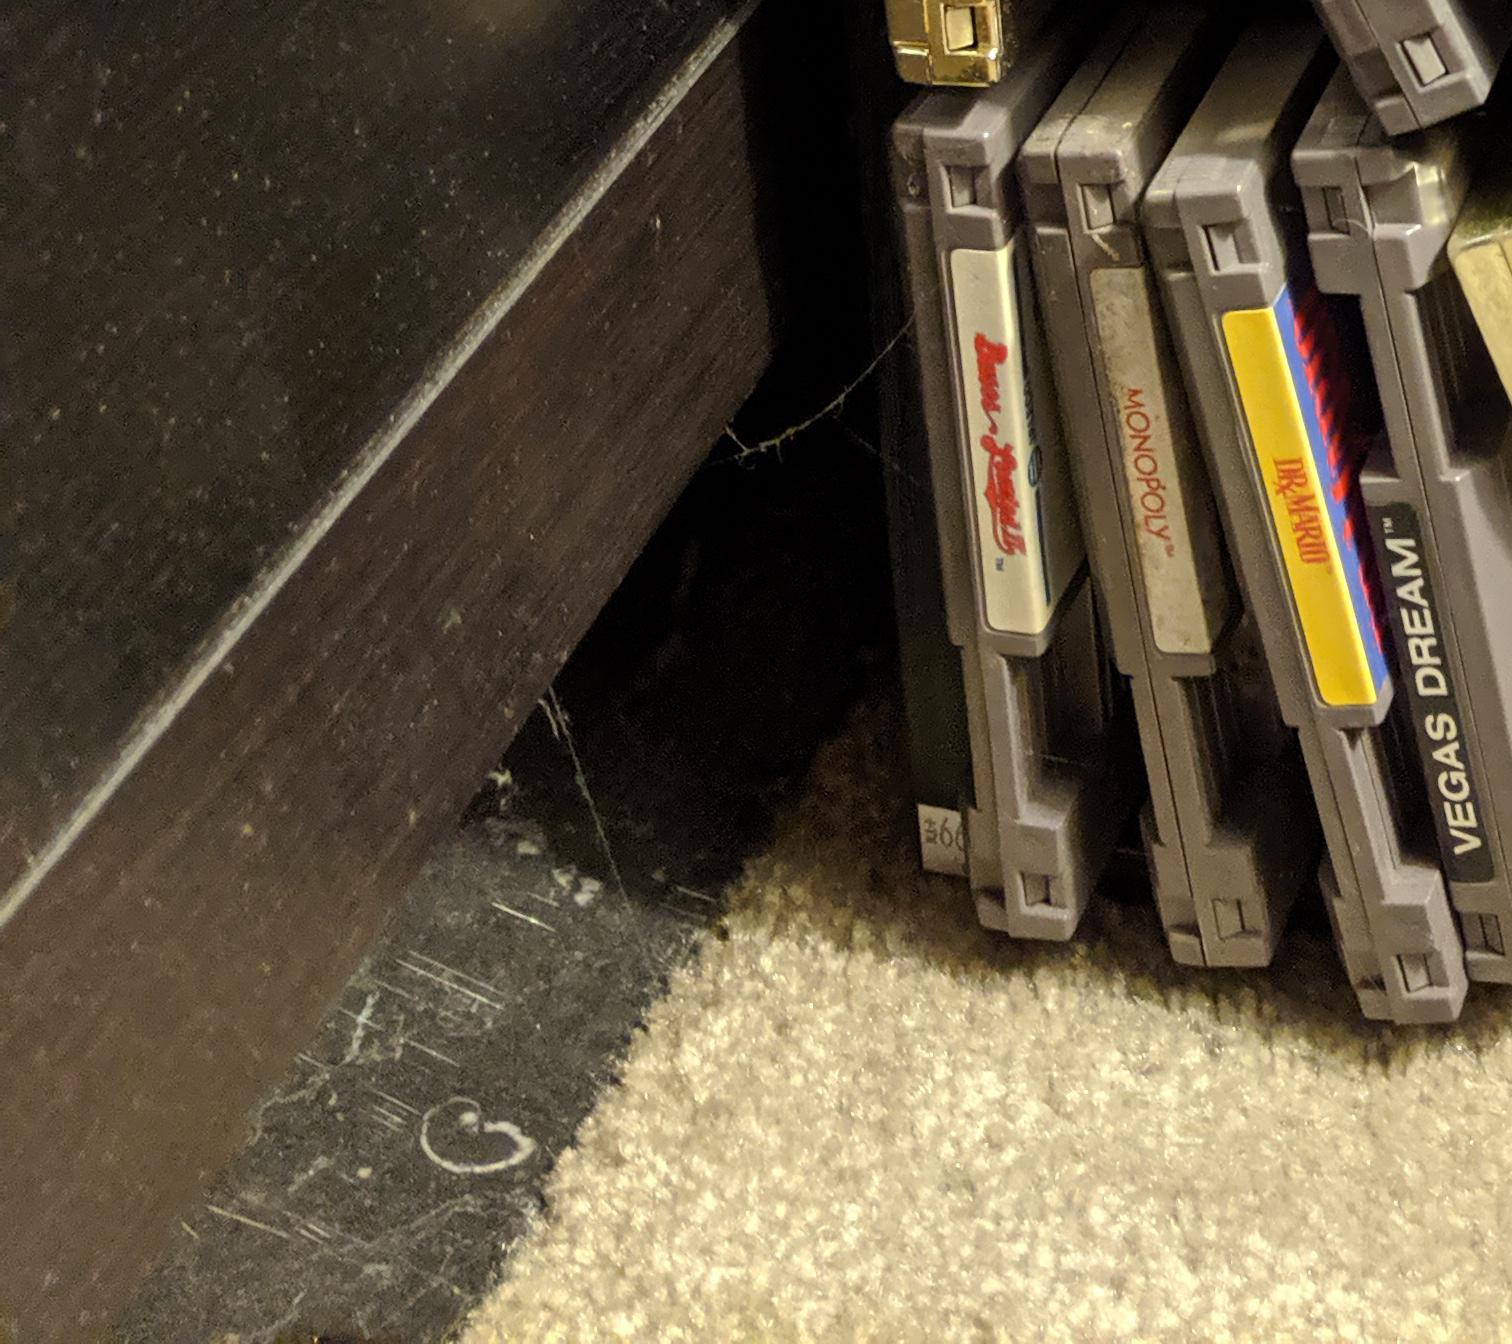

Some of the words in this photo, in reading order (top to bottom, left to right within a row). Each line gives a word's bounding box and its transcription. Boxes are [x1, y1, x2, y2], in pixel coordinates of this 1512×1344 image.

[1123, 388, 1170, 541] MONOPOLY
[1384, 538, 1449, 698] DREAM
[1426, 714, 1482, 856] VEGAS
